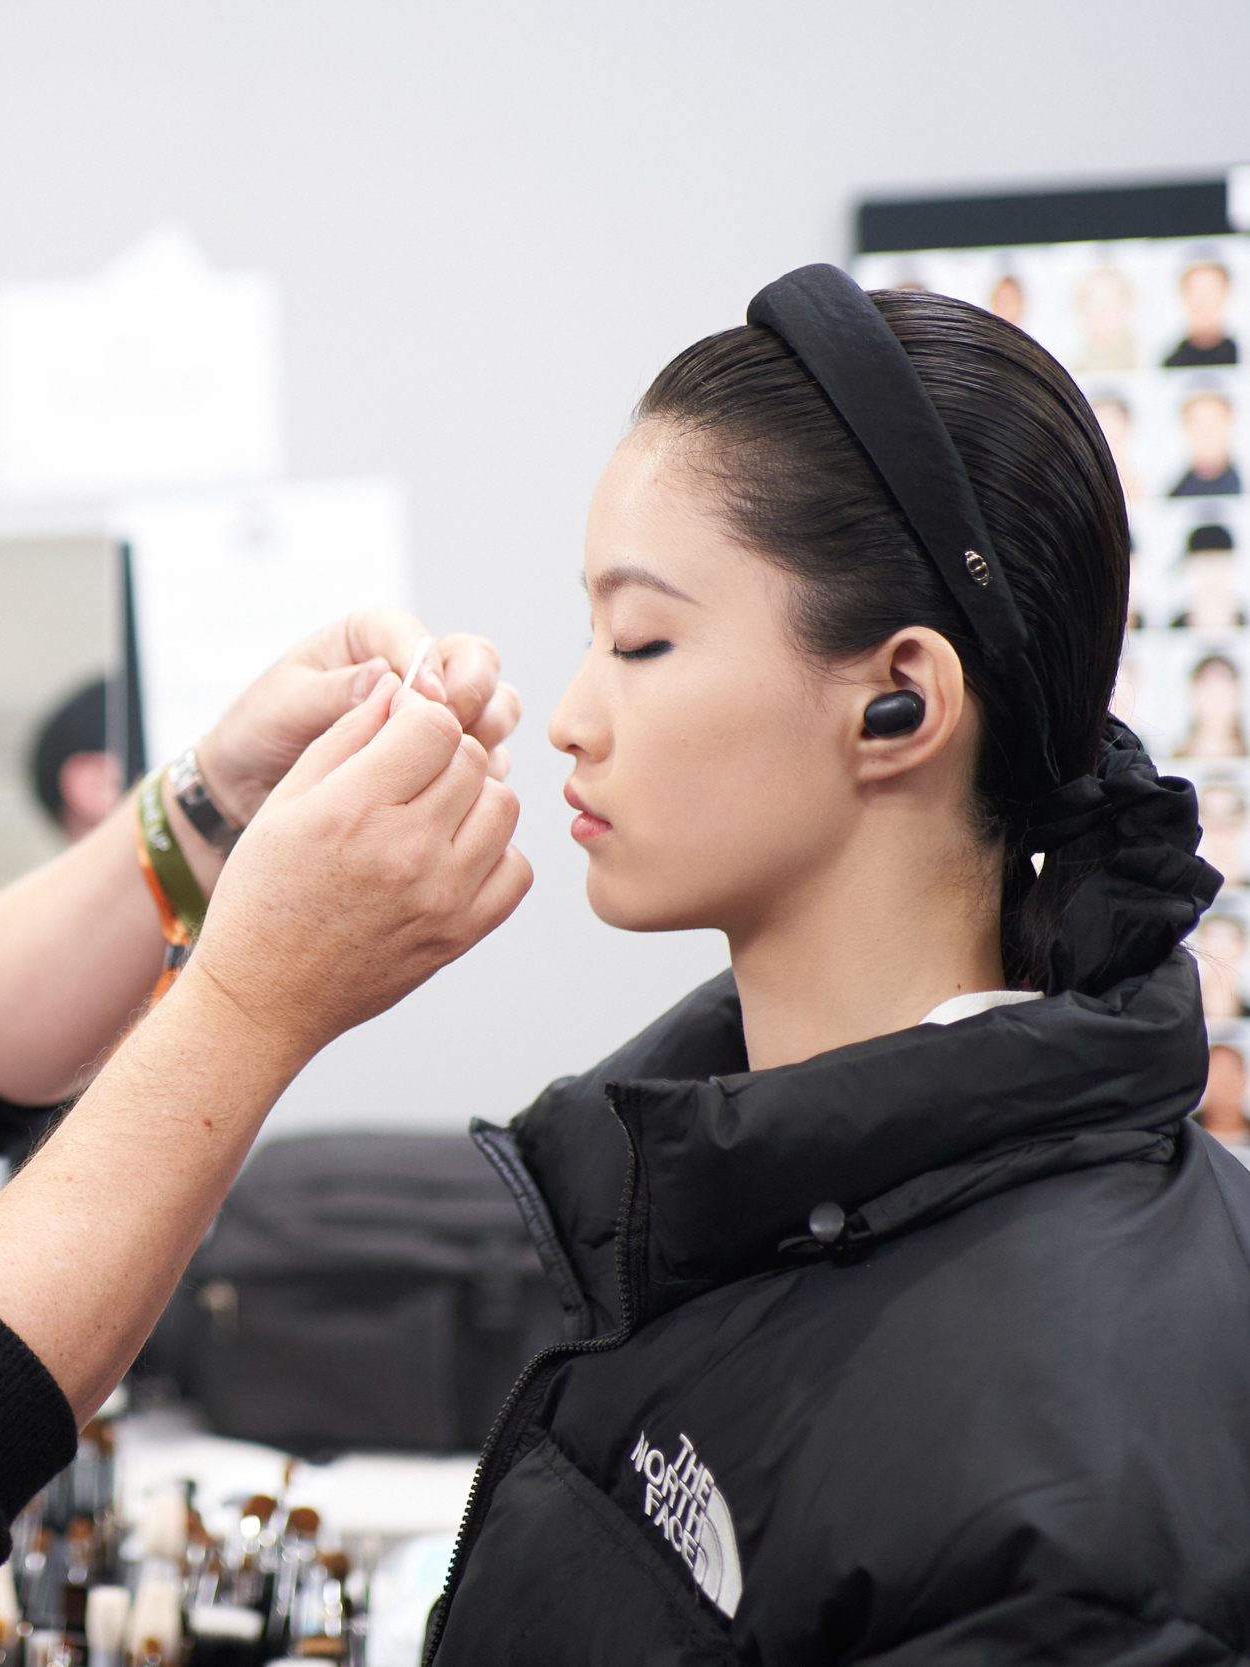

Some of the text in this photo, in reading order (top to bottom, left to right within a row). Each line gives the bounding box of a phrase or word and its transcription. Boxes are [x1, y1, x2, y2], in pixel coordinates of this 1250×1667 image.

[630, 1430, 705, 1543] NORTH
[674, 1432, 715, 1510] THE
[644, 1483, 696, 1570] FACE
